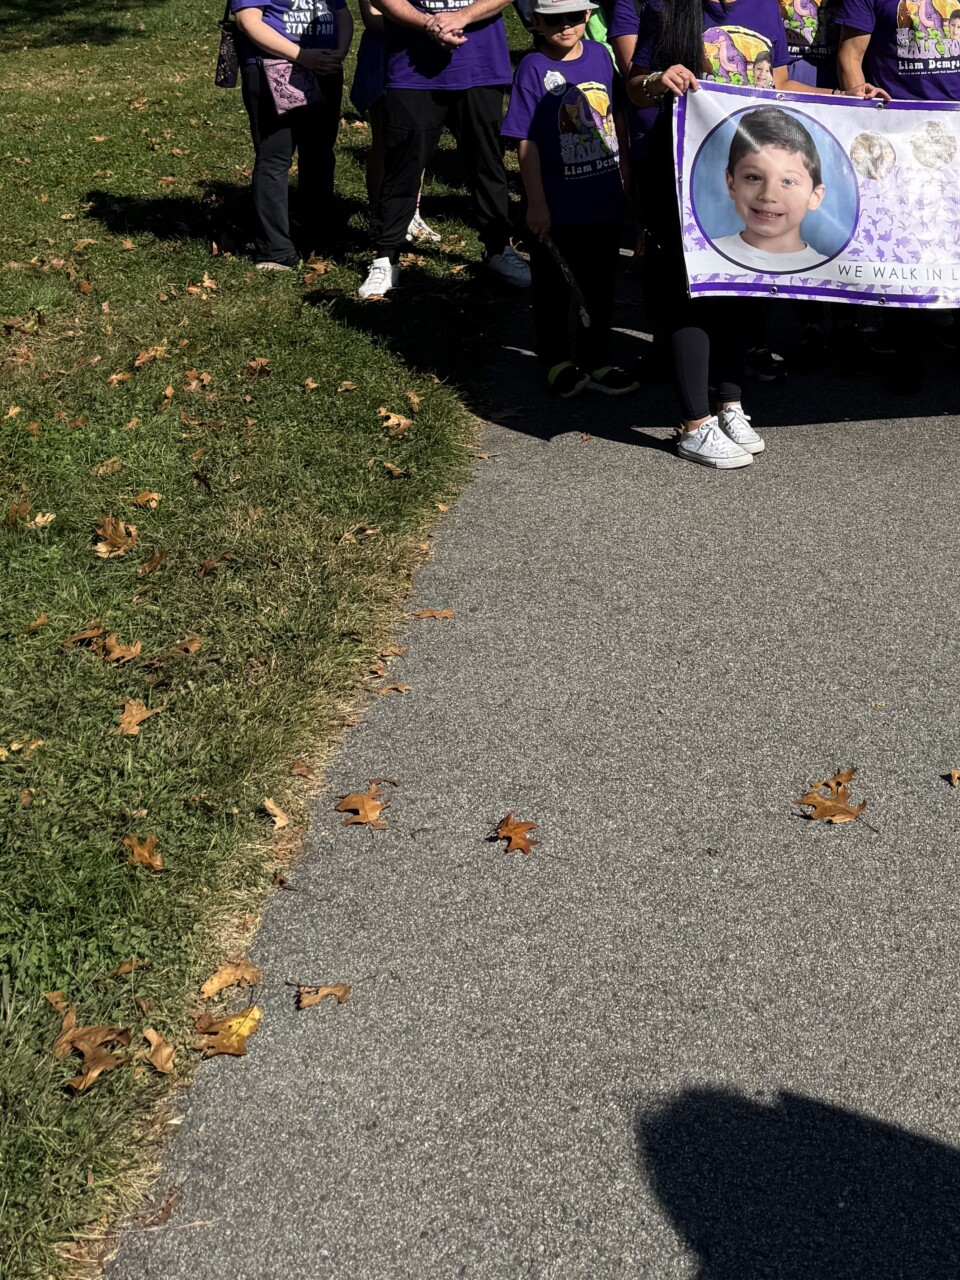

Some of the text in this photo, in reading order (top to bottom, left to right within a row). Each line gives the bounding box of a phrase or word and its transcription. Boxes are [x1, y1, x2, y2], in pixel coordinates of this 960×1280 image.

[283, 11, 311, 22] ROCKY
[286, 23, 334, 35] STATE PARK
[897, 39, 942, 59] WALK
[898, 60, 924, 70] Liam
[560, 140, 607, 164] WALK
[564, 163, 592, 175] Liam
[838, 265, 863, 278] WE
[873, 266, 918, 280] WALK
[926, 268, 942, 280] IN
